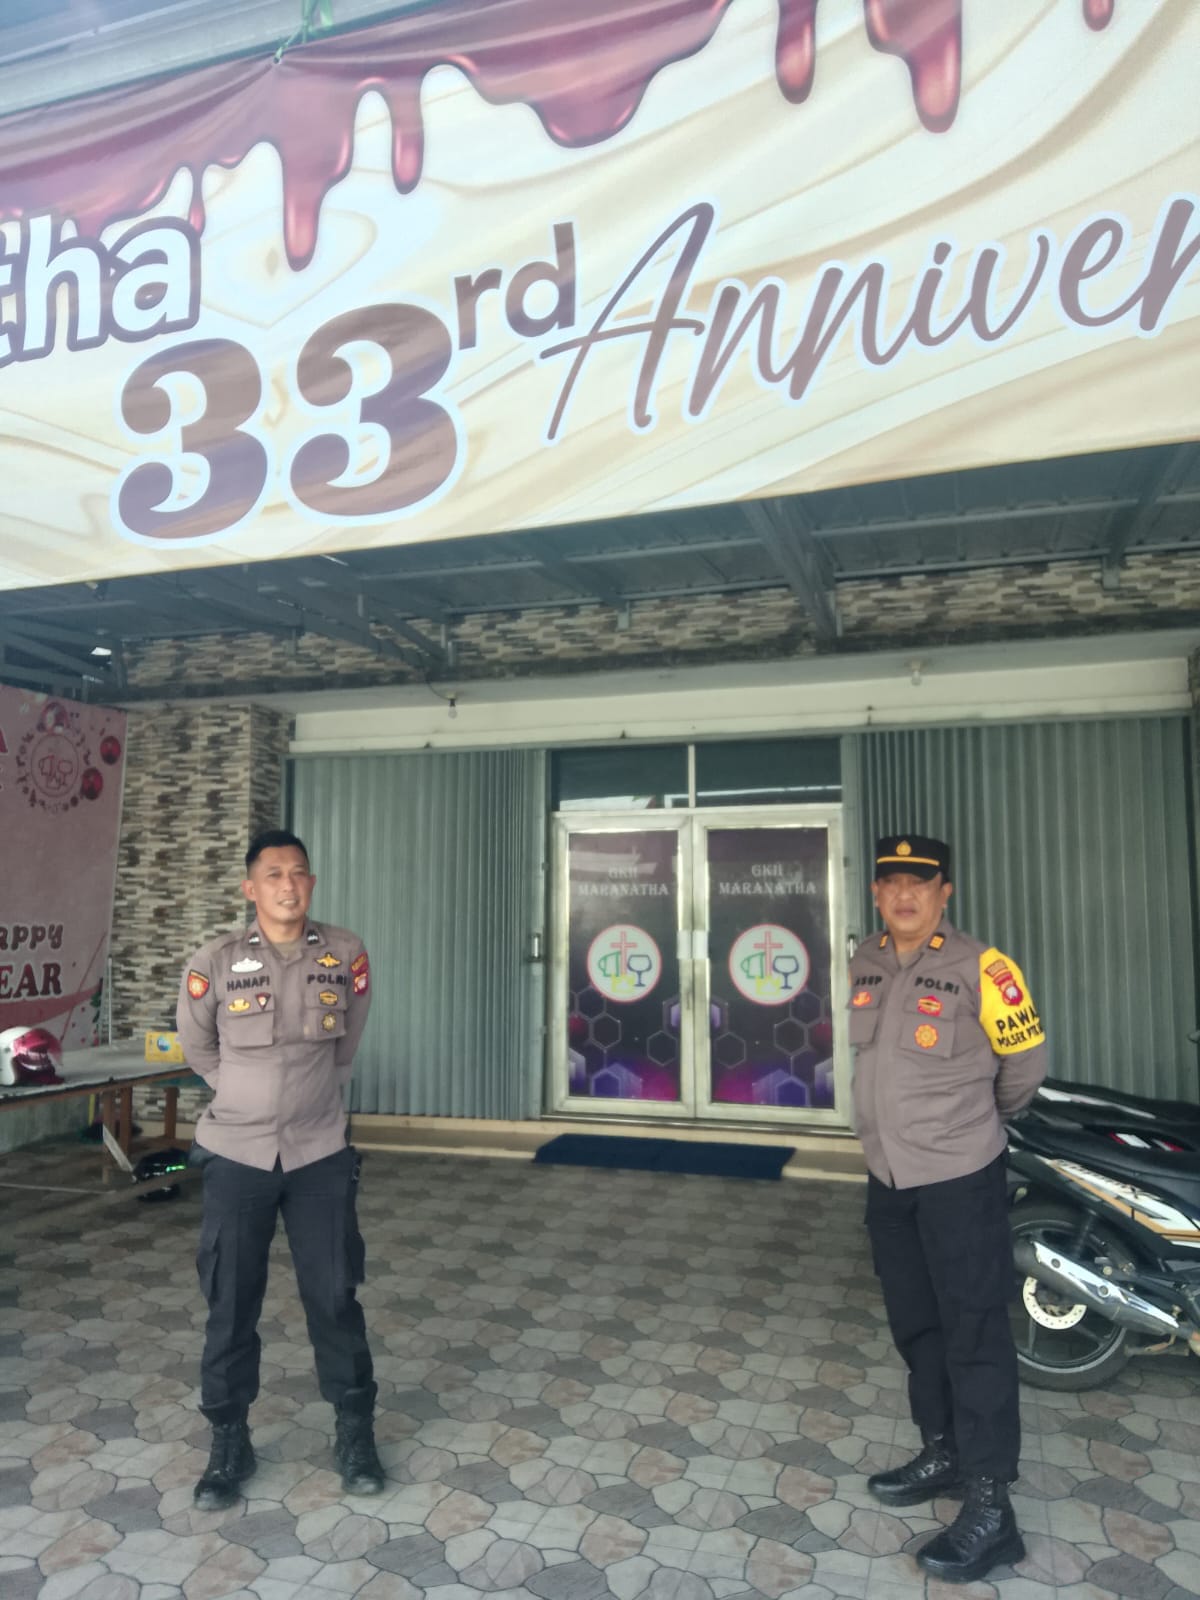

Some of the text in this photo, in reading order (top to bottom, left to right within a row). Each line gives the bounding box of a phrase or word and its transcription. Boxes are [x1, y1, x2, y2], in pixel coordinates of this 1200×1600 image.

[540, 199, 1200, 440] Anniver
[579, 882, 669, 897] MARANATHA
[719, 881, 817, 896] MARANATHA
[227, 975, 270, 992] HANAFI
[307, 974, 347, 986] POLRI
[915, 976, 960, 996] POLRI
